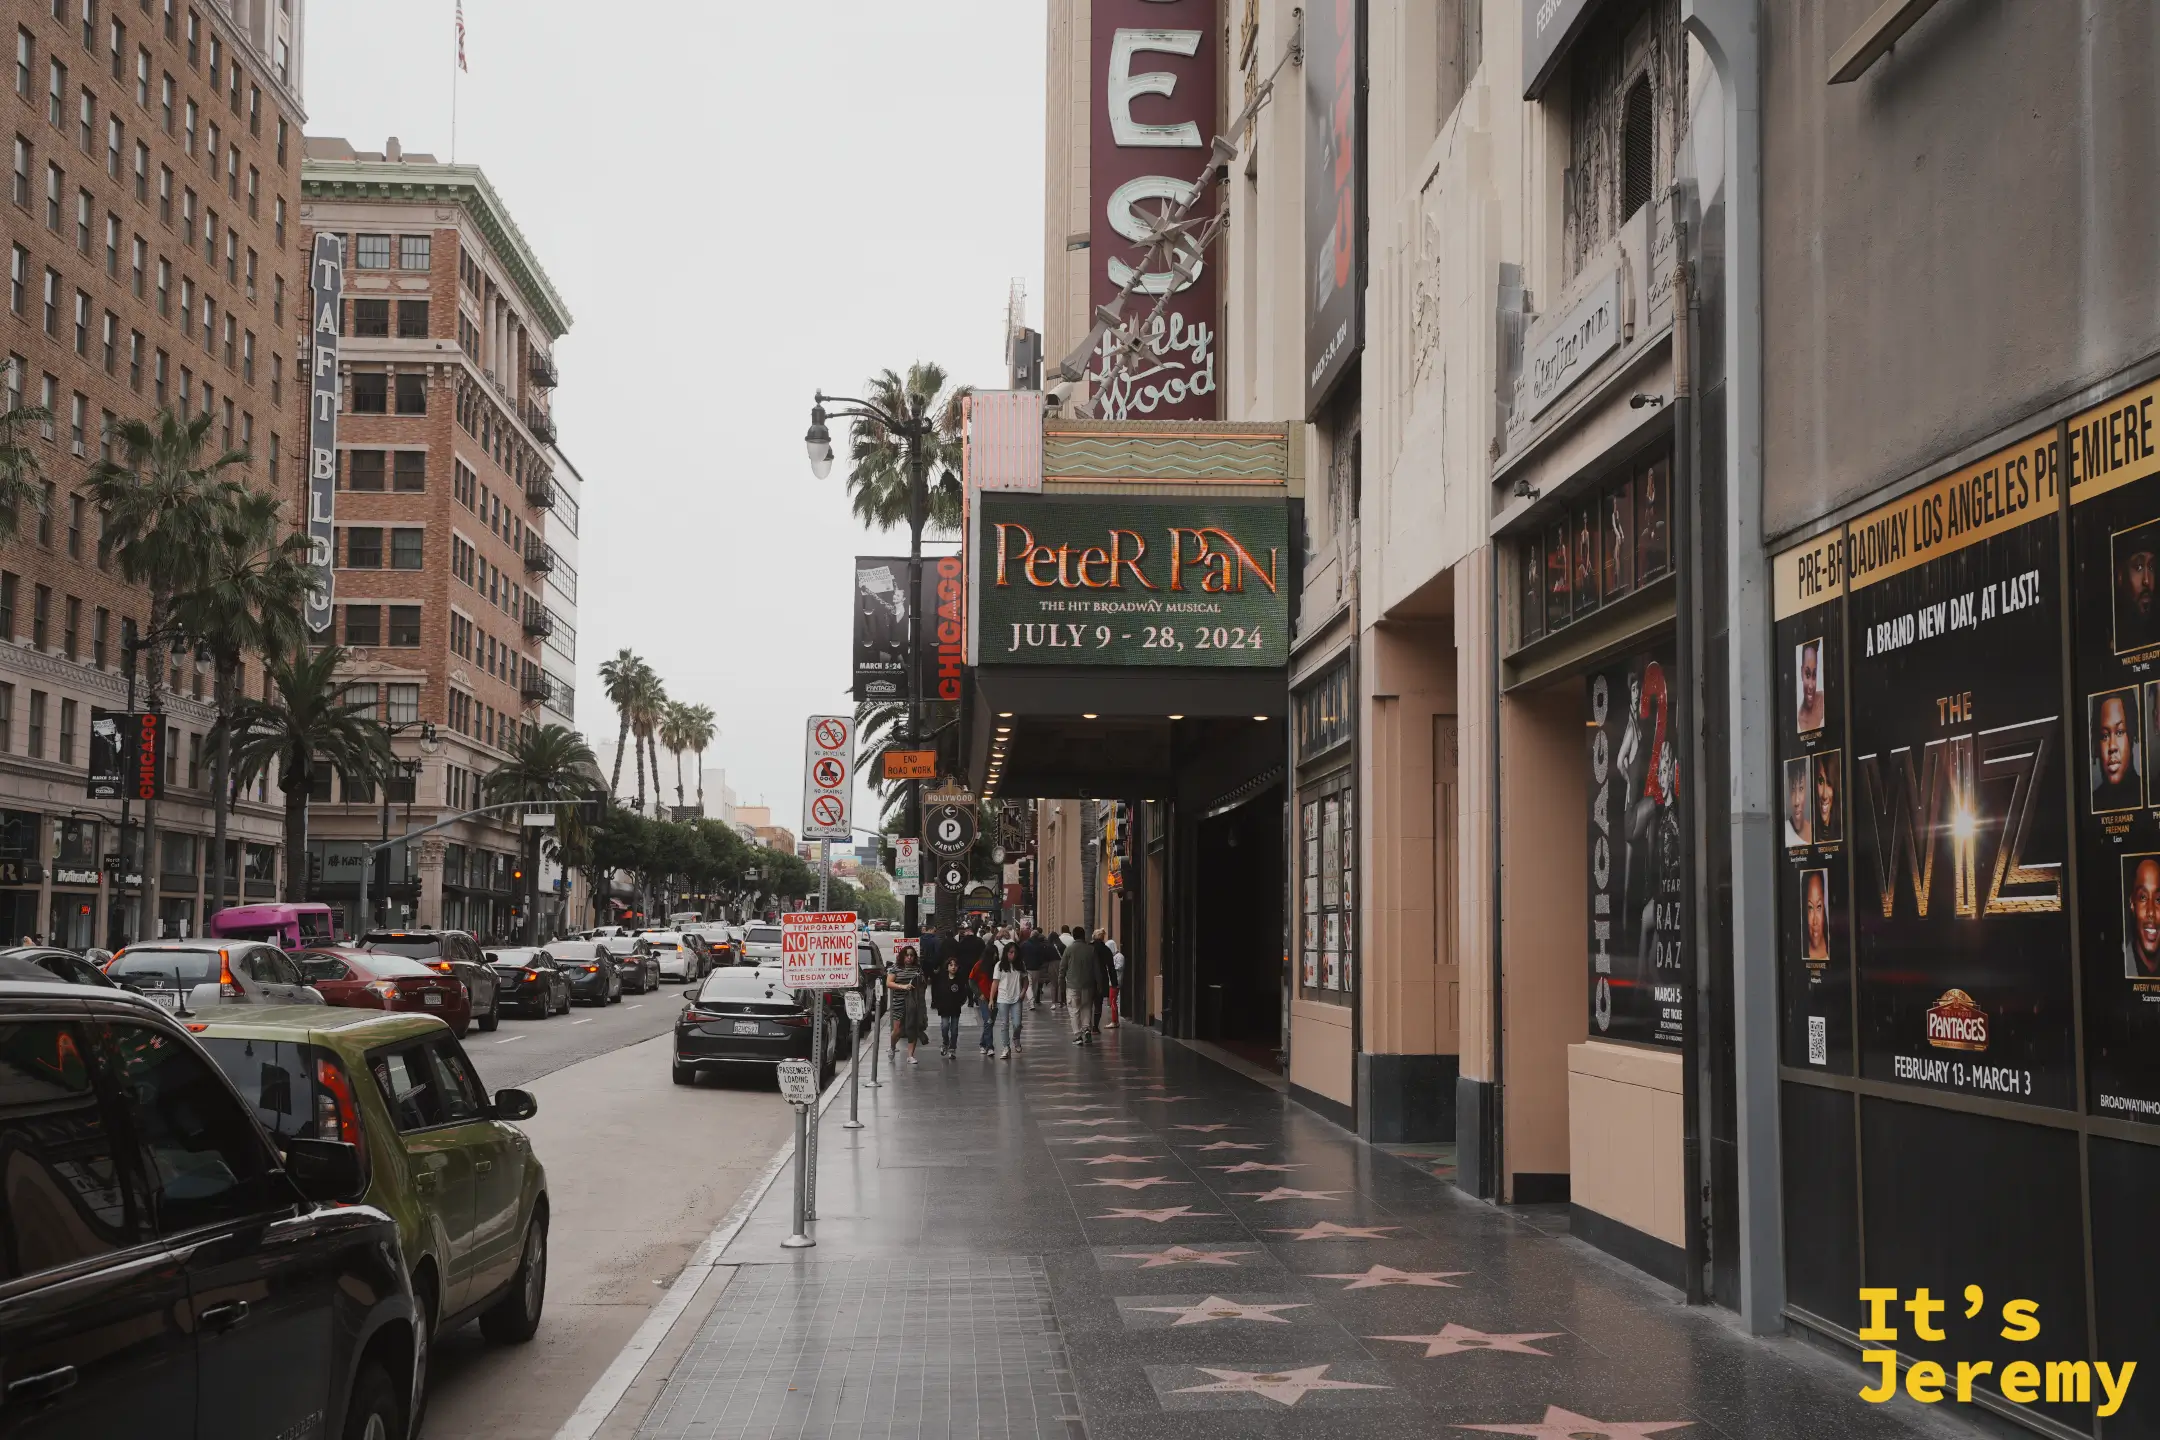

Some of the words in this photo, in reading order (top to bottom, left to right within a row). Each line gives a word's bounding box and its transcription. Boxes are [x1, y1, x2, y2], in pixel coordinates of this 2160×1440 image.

[1580, 301, 1609, 350] TOURS
[315, 259, 338, 421] TAFT
[1798, 508, 1908, 600] PRE-BROADWAY
[1913, 498, 1943, 552] LOS
[1947, 455, 2029, 538] ANGELES
[2035, 396, 2155, 503] PREMIERE
[1040, 601, 1065, 611] THE
[1068, 601, 1090, 611] HIT
[1093, 599, 1163, 613] BROADWAY
[1166, 602, 1221, 613] MUSICAL
[1866, 627, 1874, 657] A
[1876, 614, 1915, 655] BRAND
[1918, 601, 1946, 640] NEW
[1950, 592, 1977, 631] DAY,
[1981, 583, 1998, 619] AT
[2002, 569, 2040, 614] LAST!
[937, 556, 962, 700] CHICAGO
[1008, 623, 1087, 652] JULY
[1095, 625, 1111, 649] 9
[1142, 626, 1184, 652] 28,
[1194, 626, 1263, 649] 2024
[2121, 654, 2142, 666] WAYNE
[2132, 665, 2141, 673] The
[2141, 663, 2150, 671] Wiz
[1937, 691, 1972, 726] THE
[140, 714, 157, 799] CHICAGO
[1858, 716, 2062, 919] WIZ
[2101, 816, 2114, 825] KYLE
[2114, 814, 2134, 823] RAMAR
[946, 823, 956, 838] P
[2105, 825, 2130, 834] FREEMAN
[934, 840, 965, 852] PARKING
[1593, 674, 1611, 1031] CHICAGO
[1656, 902, 1681, 930] RAZ
[786, 934, 806, 951] NO
[809, 936, 853, 949] PARKING
[789, 953, 816, 967] ANY
[821, 952, 852, 966] TIME
[1656, 941, 1681, 969] DAZ
[1654, 986, 1675, 1003] MARCH
[2133, 984, 2149, 992] AVERY
[1662, 1008, 1670, 1019] GET
[1940, 1010, 1972, 1018] HOLLYWOOD
[1929, 1013, 1986, 1041] PANTAGES
[779, 1066, 812, 1074] PASSENGER
[1894, 1056, 1949, 1083] FEBRUARY
[1952, 1061, 1964, 1086] 13
[1972, 1067, 2020, 1094] MARCH
[2024, 1071, 2031, 1095] 3
[2100, 1094, 2160, 1115] BROADWAYINHO
